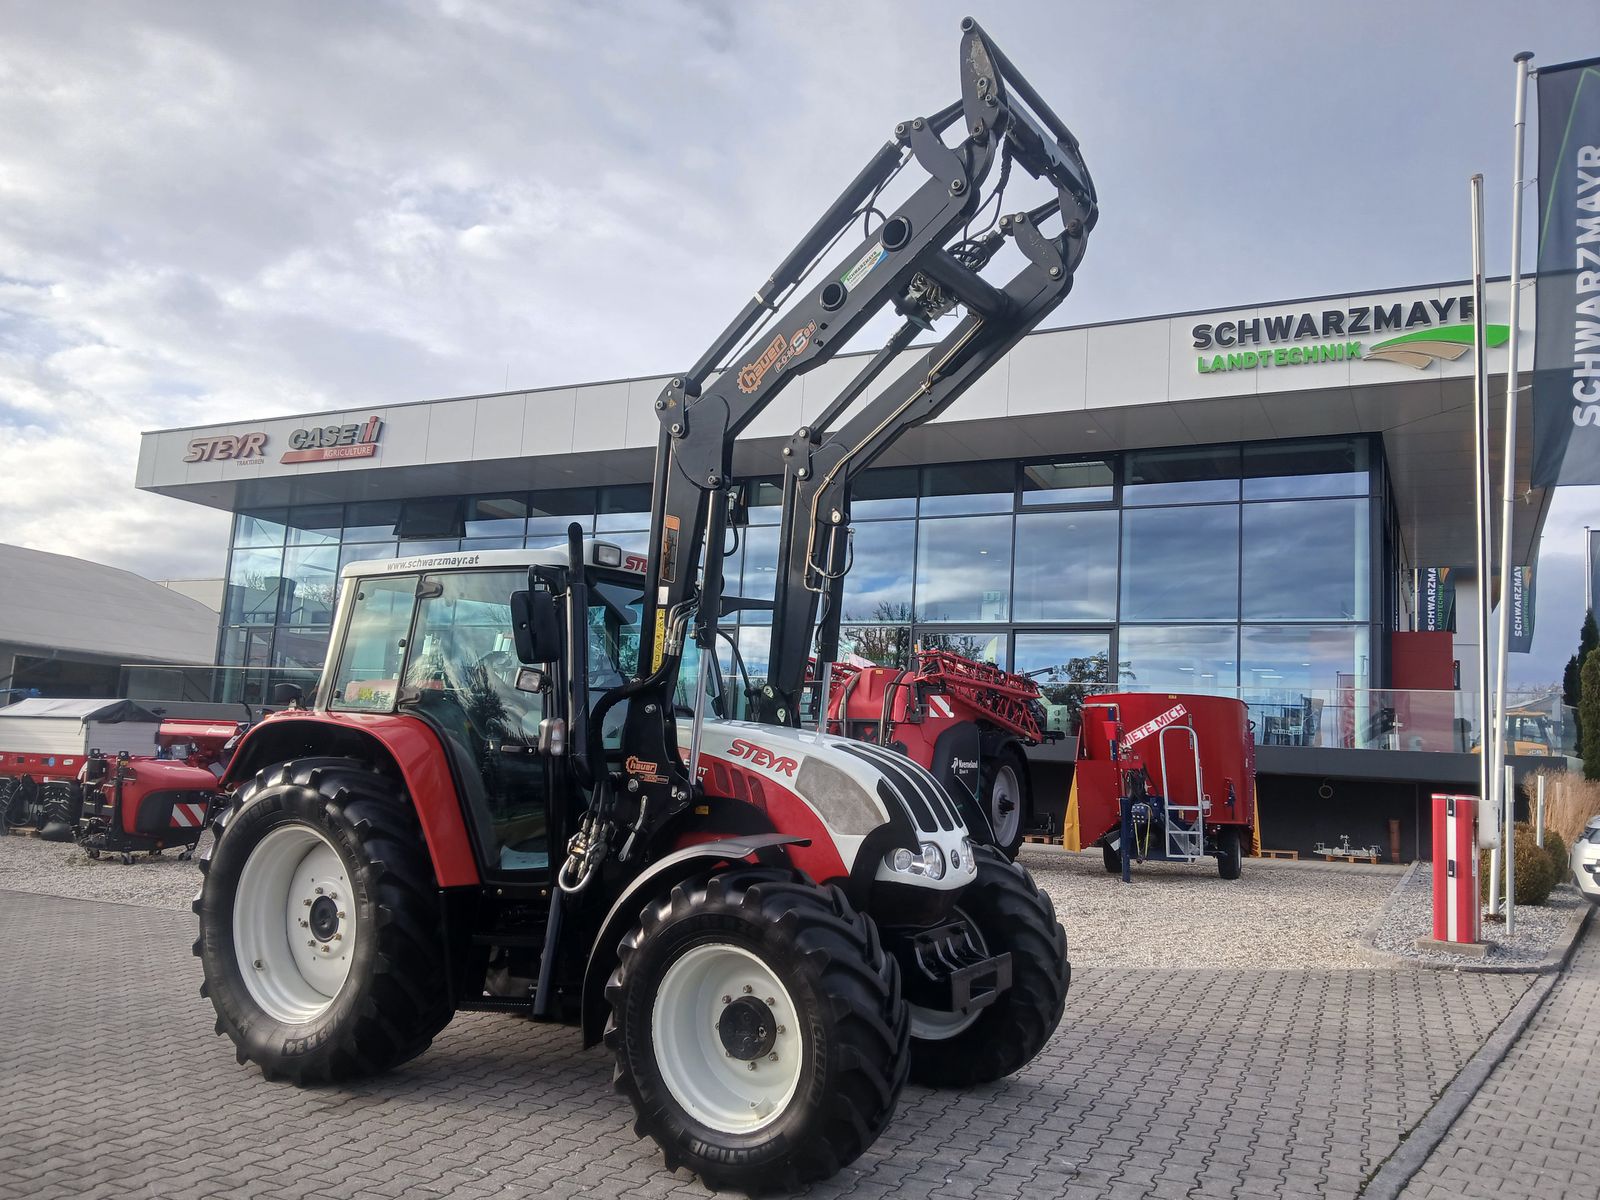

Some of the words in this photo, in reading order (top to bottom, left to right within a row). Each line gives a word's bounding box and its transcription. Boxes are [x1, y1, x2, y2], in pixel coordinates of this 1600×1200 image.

[1573, 144, 1600, 428] SCHWARZMAYR
[1197, 341, 1362, 374] LANDTECHNIK
[183, 432, 267, 463] STEYR
[288, 423, 359, 450] CASE
[323, 446, 371, 459] AGRICULTURE
[387, 555, 480, 571] www.schwarzmayr.at
[1154, 704, 1186, 728] MICH
[727, 739, 799, 777] STEYR
